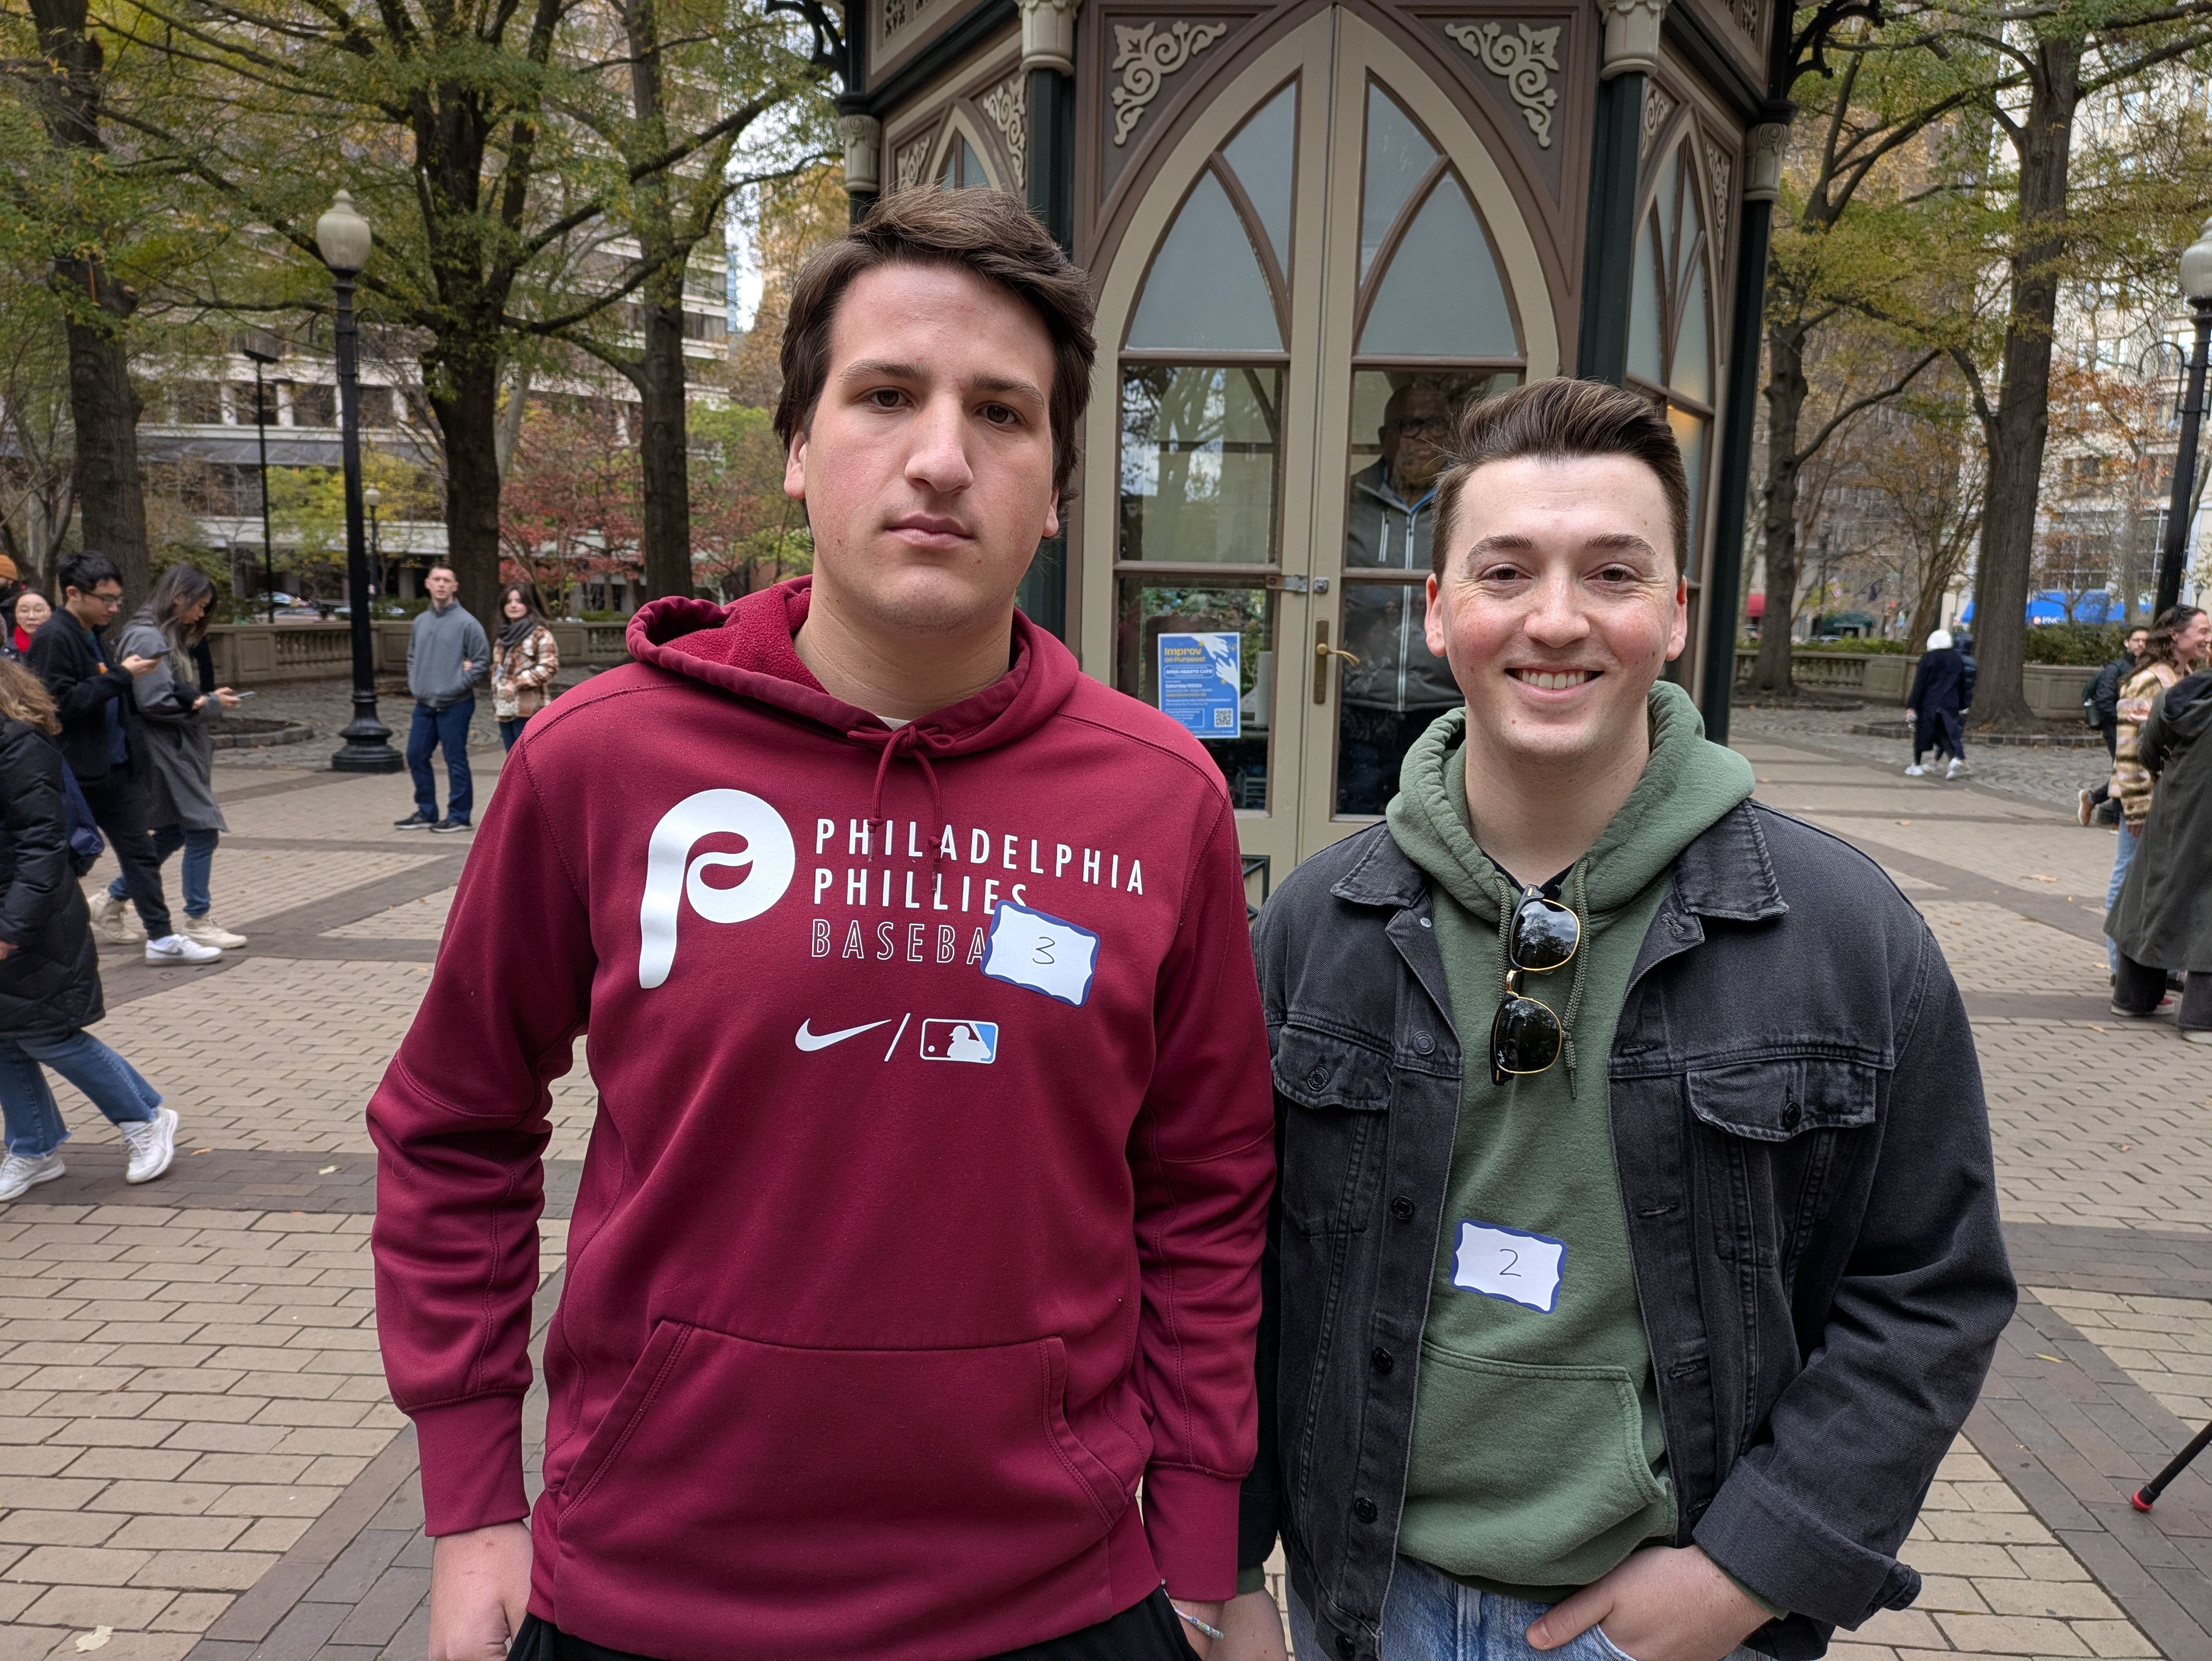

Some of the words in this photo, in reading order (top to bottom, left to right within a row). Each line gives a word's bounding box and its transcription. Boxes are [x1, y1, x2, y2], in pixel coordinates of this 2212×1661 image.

[1164, 647, 1202, 656] Improv
[816, 819, 1143, 895] PHILADELPHIA
[814, 868, 1027, 915] PHILLIES
[811, 919, 986, 964] BASEBA
[1032, 936, 1056, 964] 3
[1499, 1249, 1522, 1277] 2
